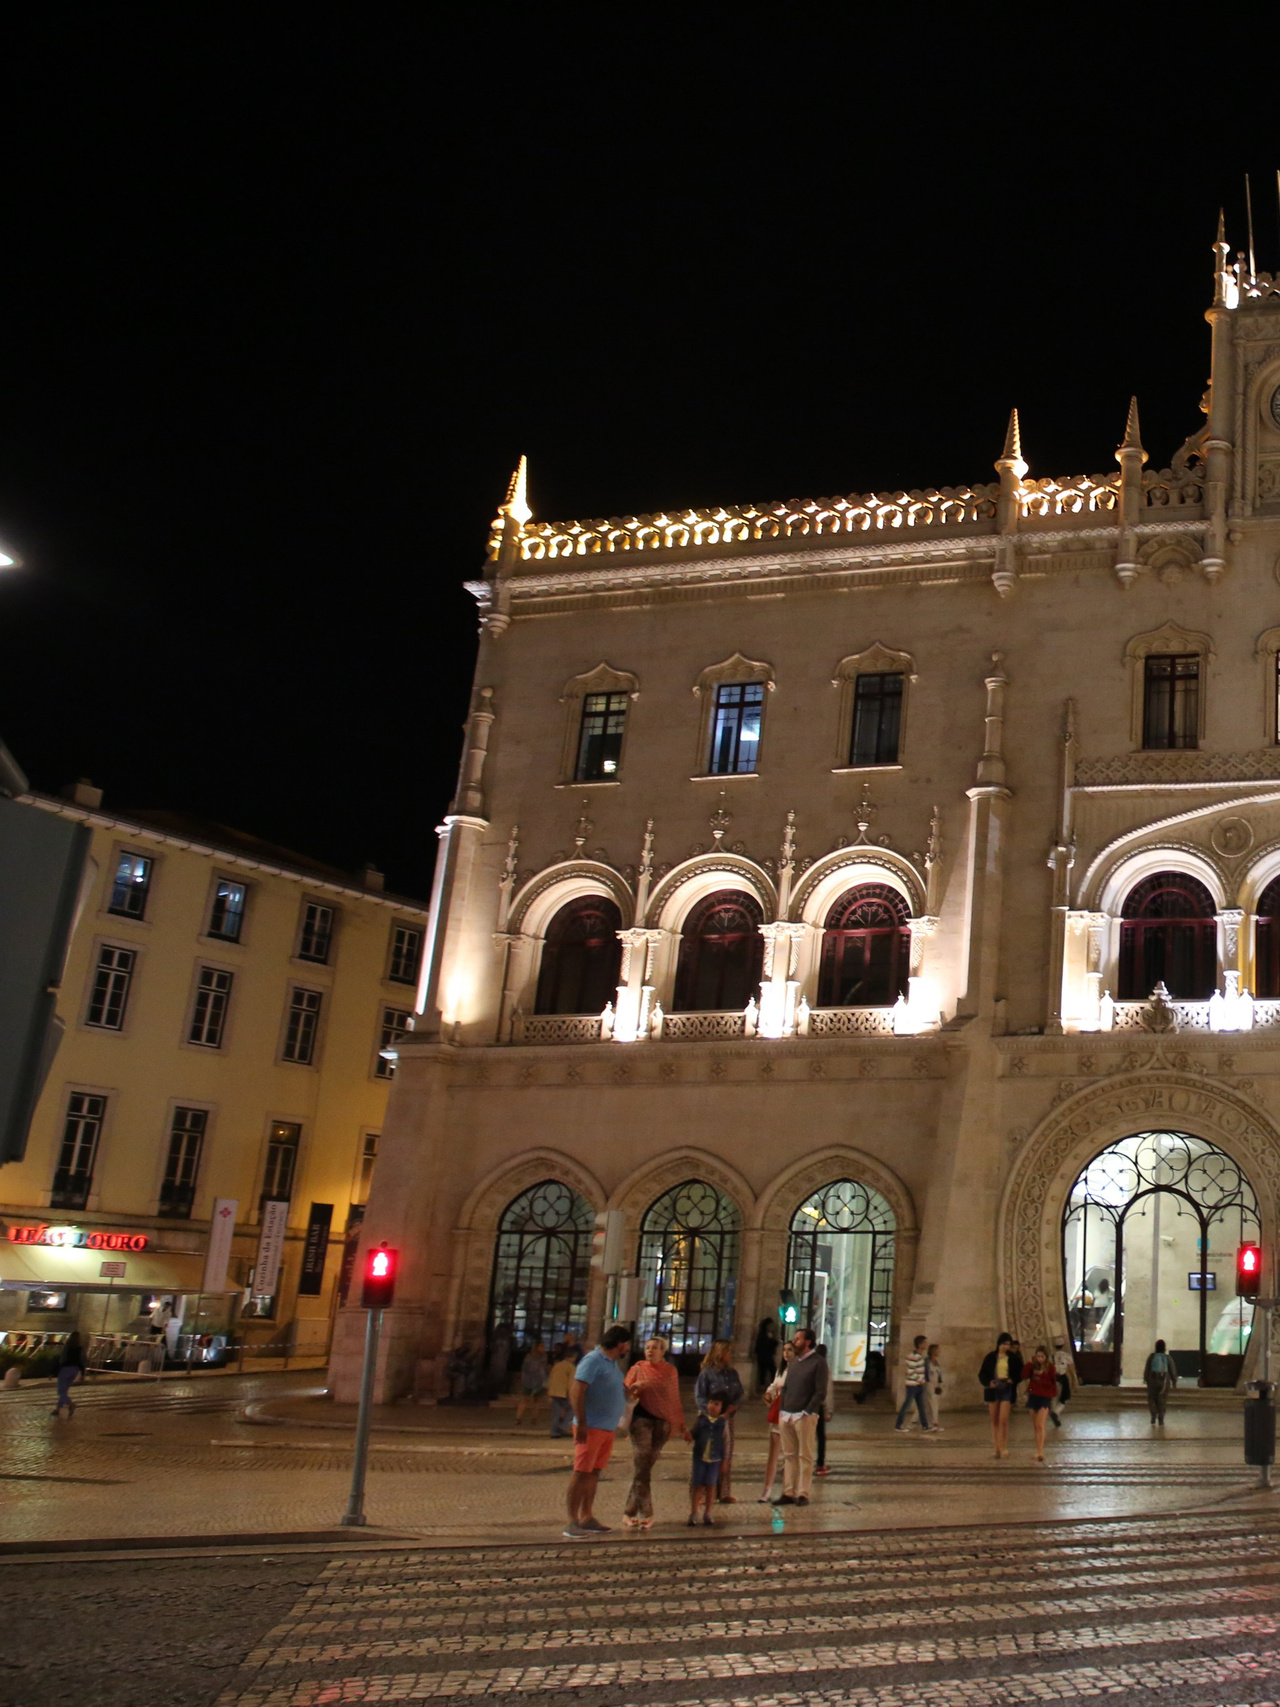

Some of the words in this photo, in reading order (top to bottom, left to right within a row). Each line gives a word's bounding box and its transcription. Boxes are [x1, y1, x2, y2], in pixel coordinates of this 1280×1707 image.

[310, 1223, 321, 1243] BAR
[261, 1240, 271, 1252] da
[304, 1245, 317, 1273] IRISH
[256, 1254, 269, 1291] Cozinha
